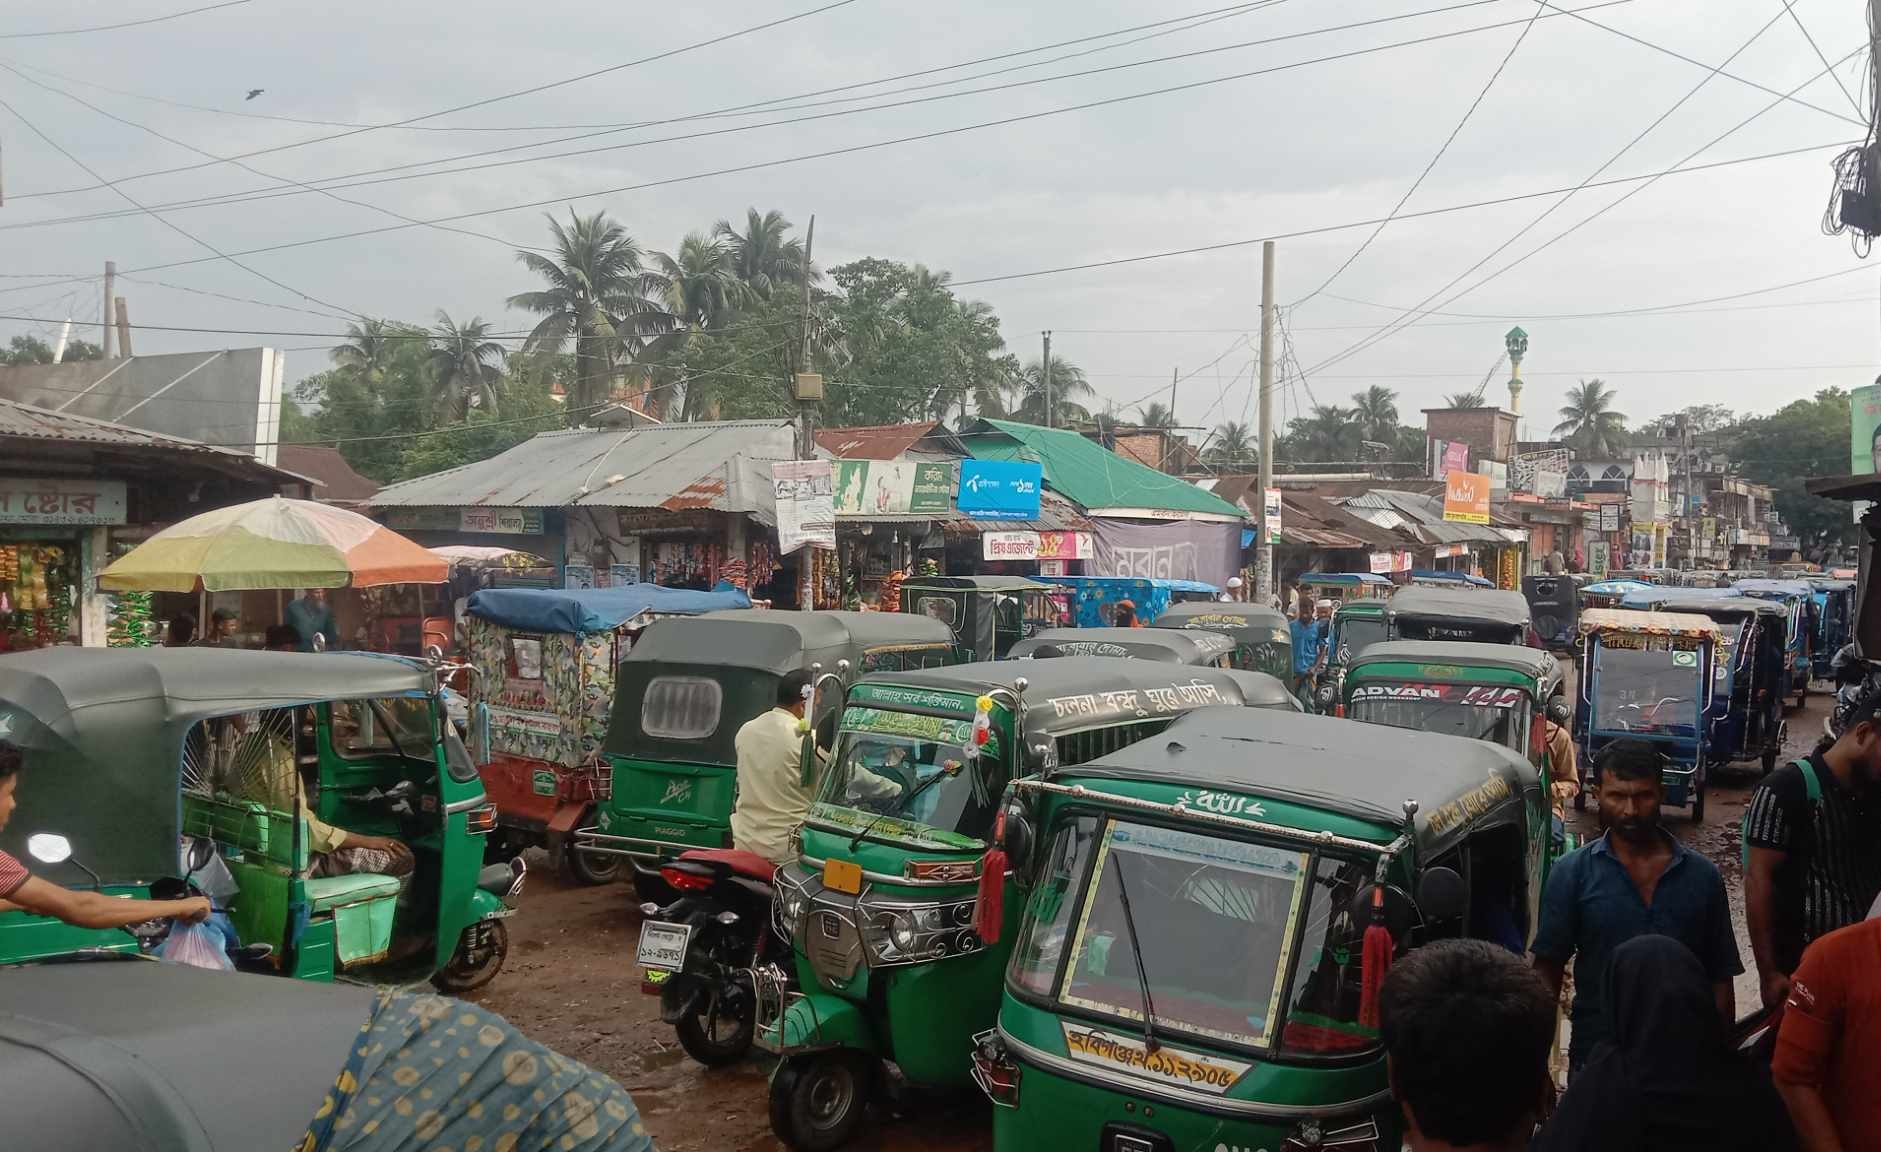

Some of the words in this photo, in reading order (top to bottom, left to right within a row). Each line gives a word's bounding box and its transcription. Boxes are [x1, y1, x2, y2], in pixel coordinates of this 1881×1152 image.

[1048, 694, 1098, 718] চলনা
[1099, 690, 1149, 717] বন্ধু
[1144, 684, 1180, 713] ঘুরে
[1351, 686, 1440, 698] ADVAN
